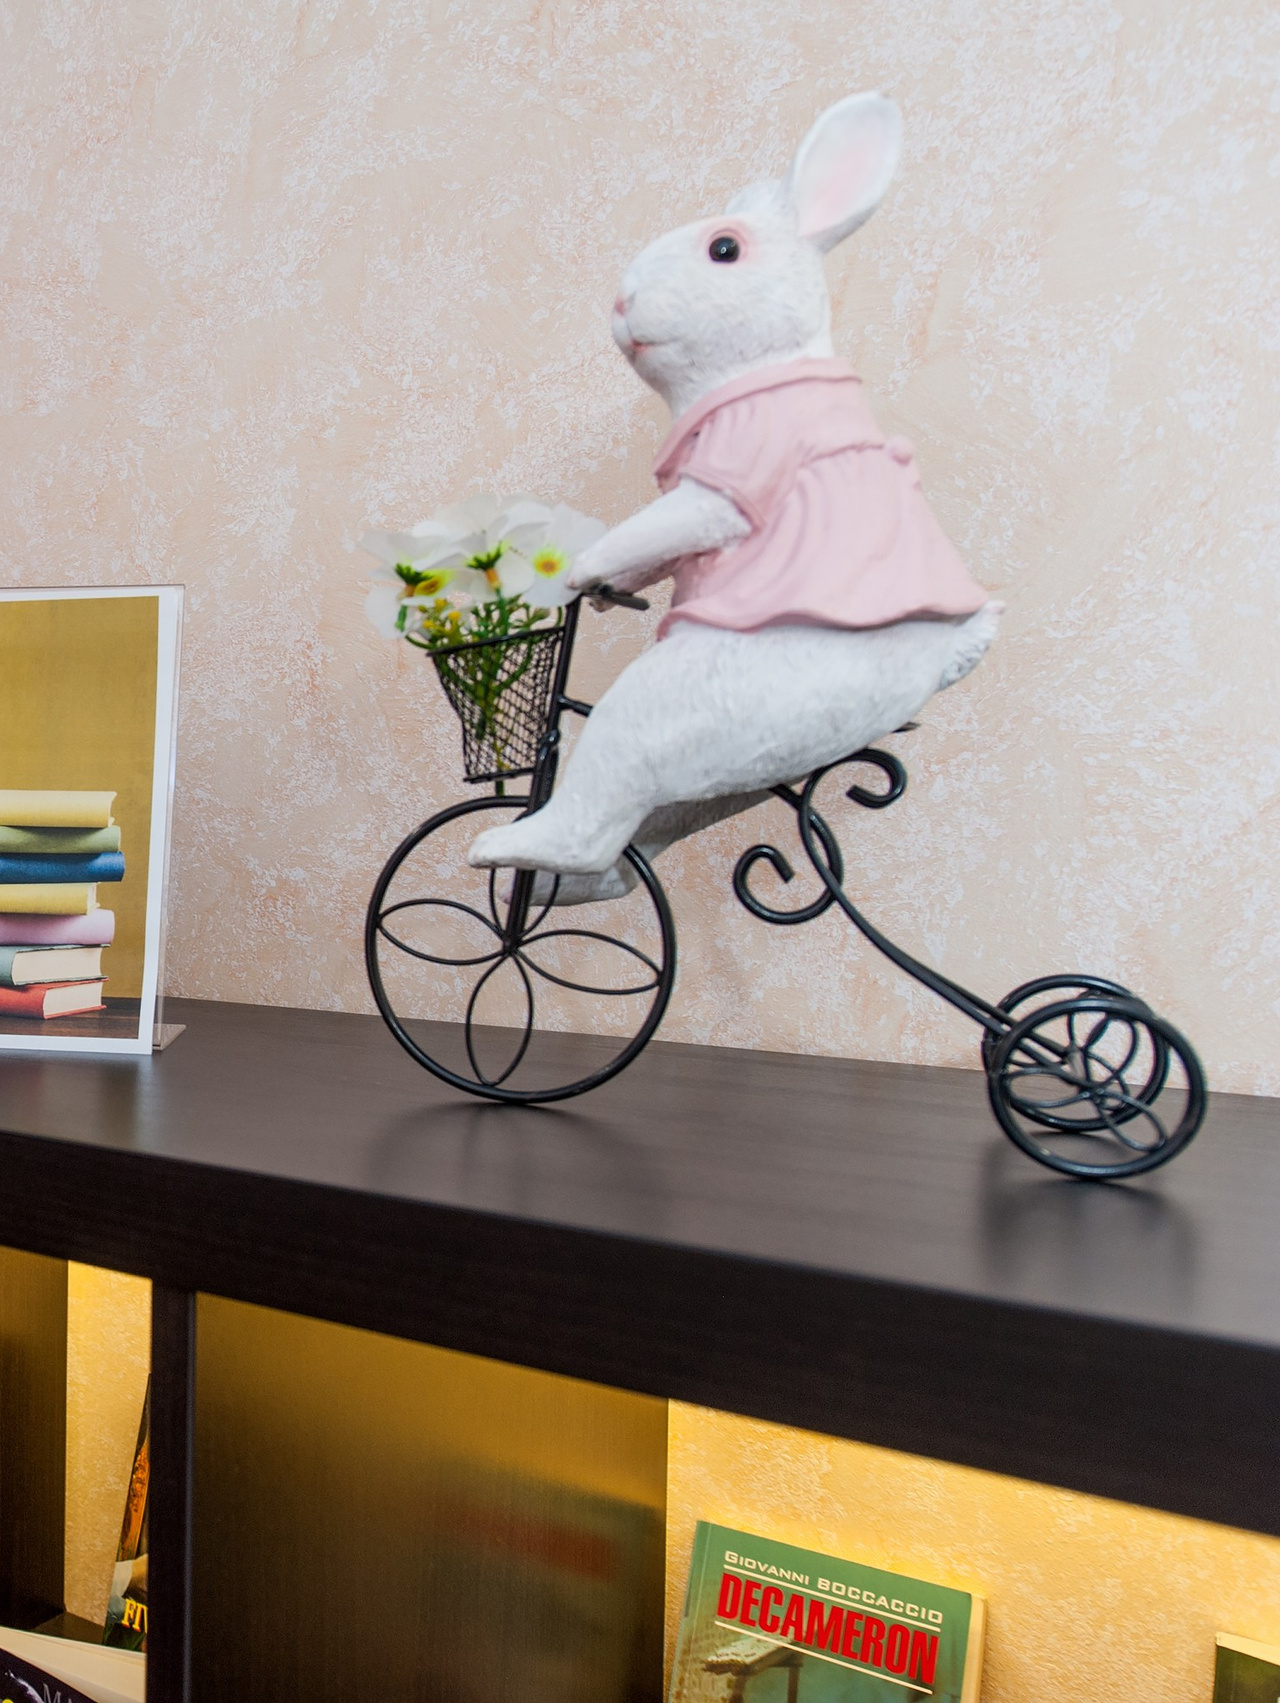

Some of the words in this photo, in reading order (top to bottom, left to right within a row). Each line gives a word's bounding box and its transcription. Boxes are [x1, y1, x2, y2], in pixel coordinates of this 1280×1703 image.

[716, 1572, 939, 1685] DECAMERON
[724, 1550, 810, 1586] GIOVANNI
[817, 1577, 943, 1625] BOCCACCIO
